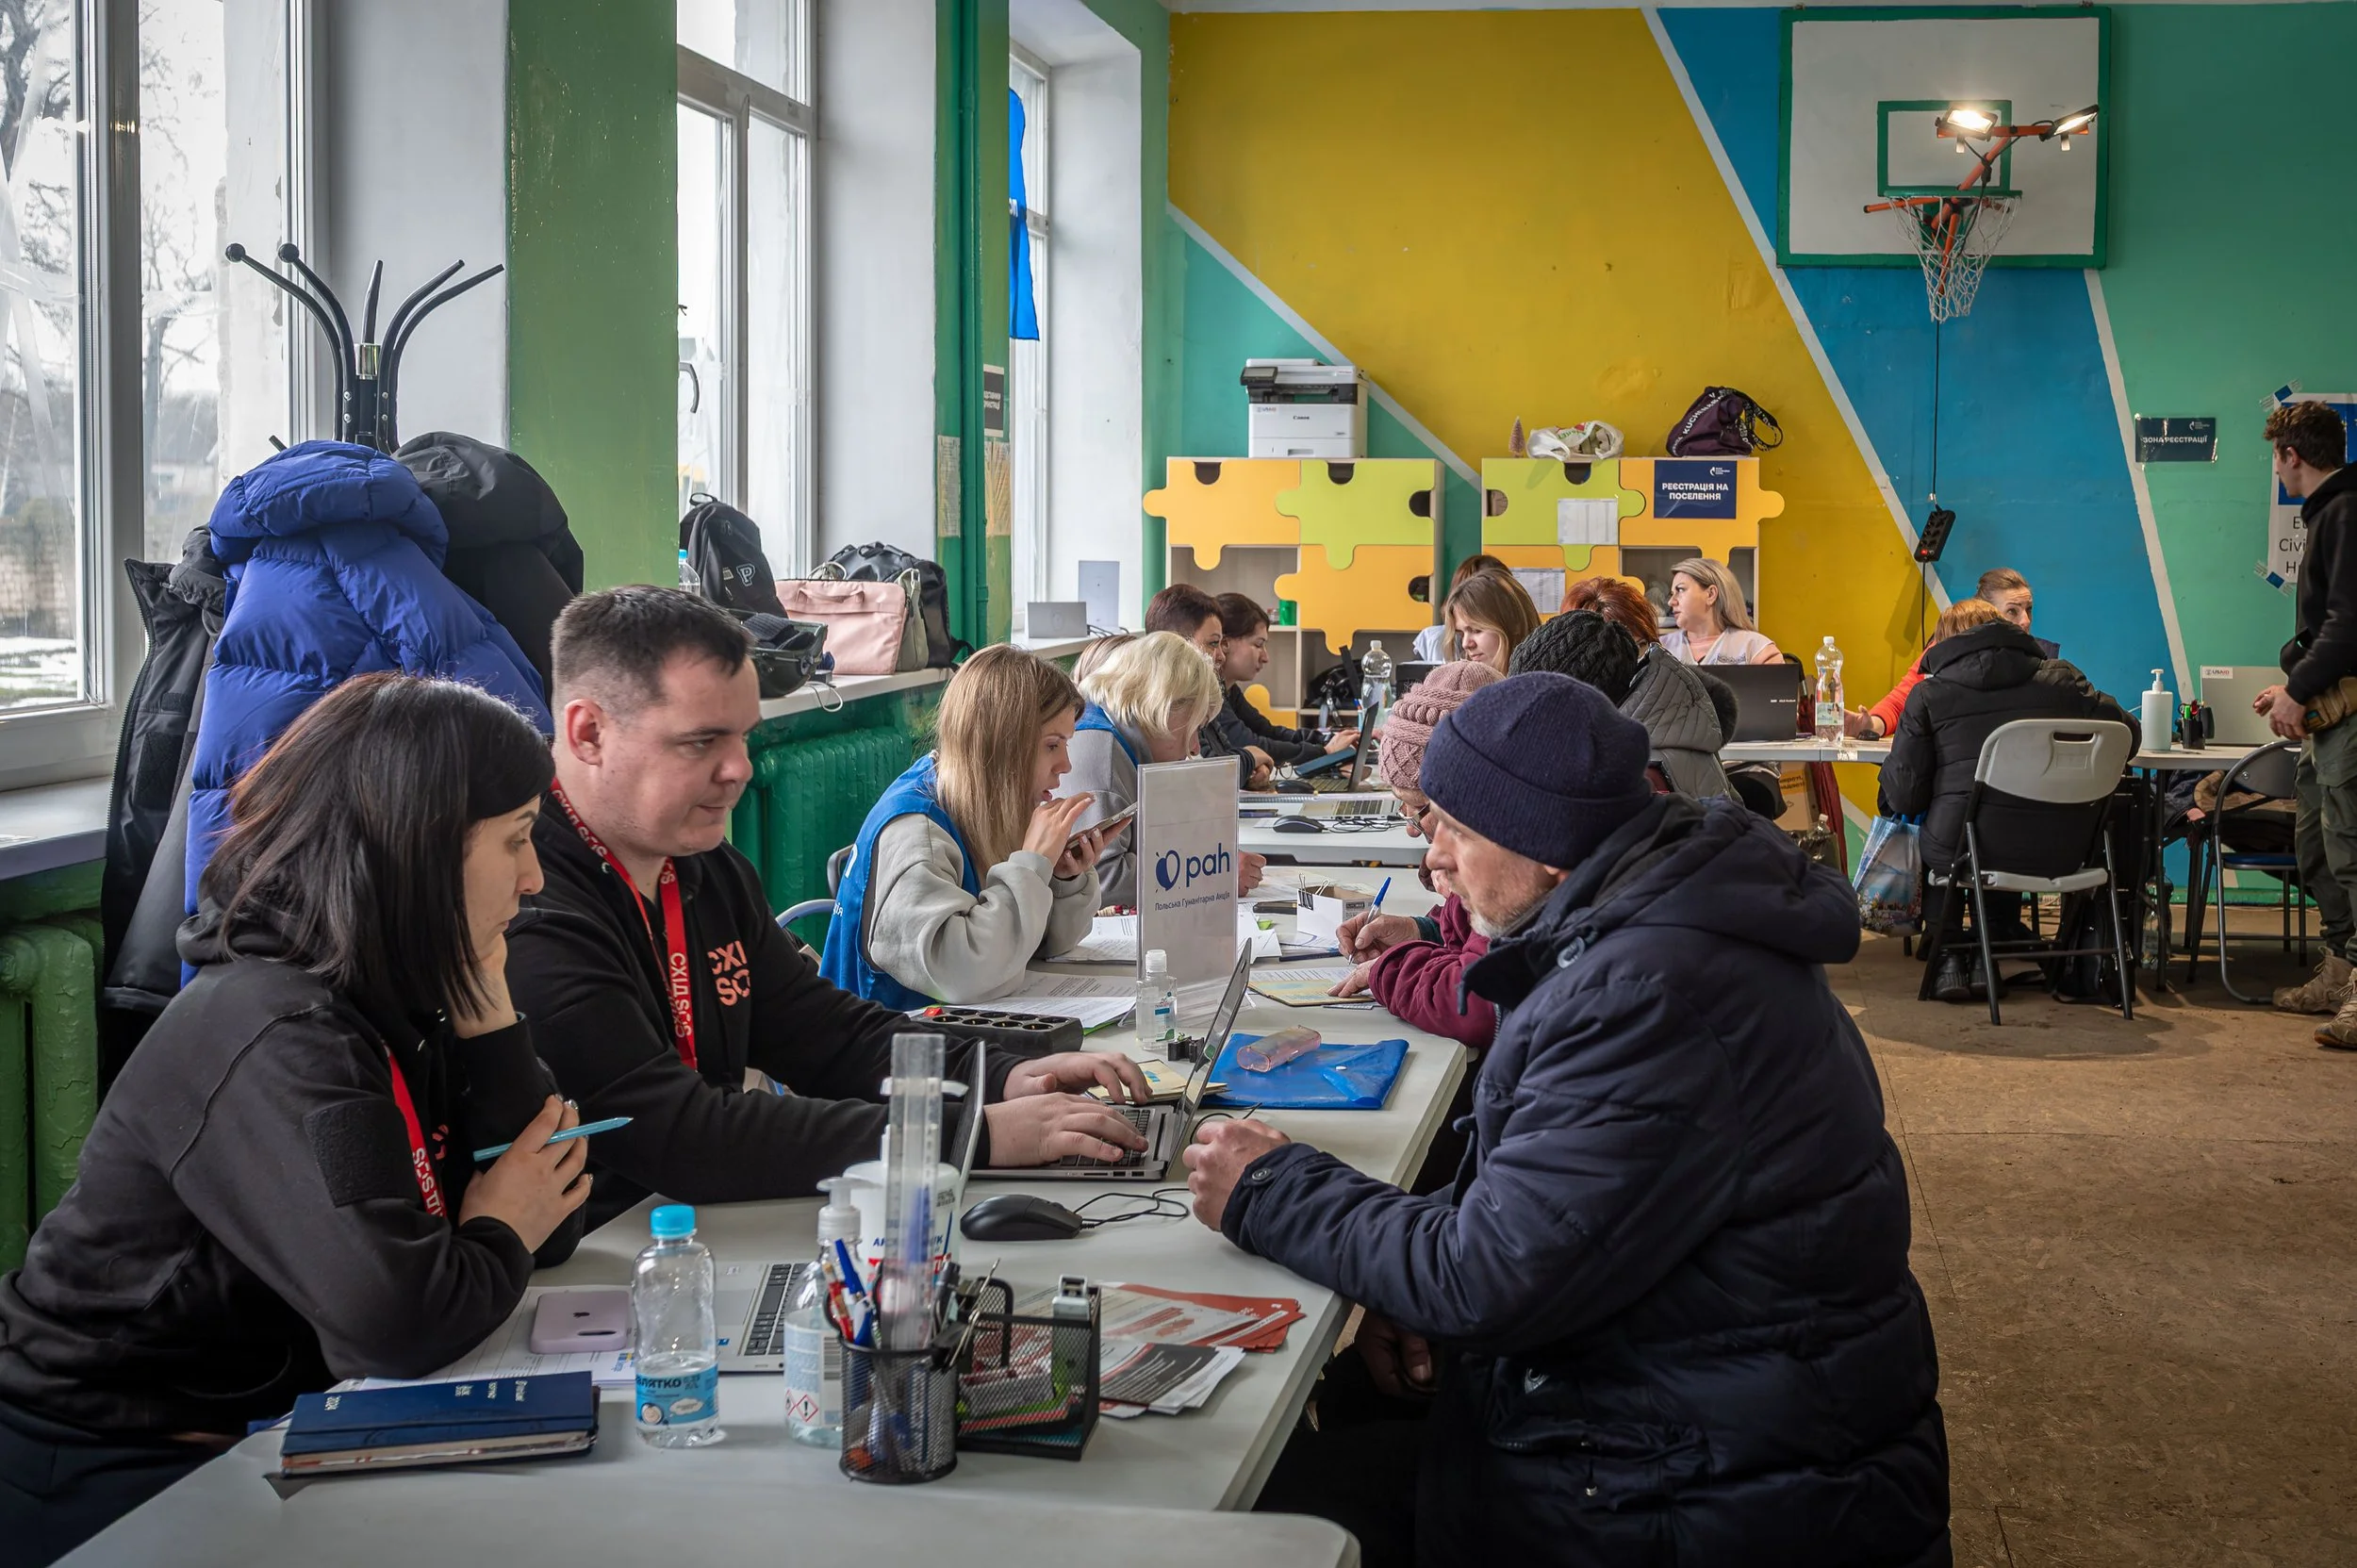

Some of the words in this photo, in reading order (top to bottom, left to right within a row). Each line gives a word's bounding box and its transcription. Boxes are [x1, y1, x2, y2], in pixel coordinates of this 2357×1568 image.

[1662, 483, 1714, 491] РЕЄСТРАЦІЯ
[1669, 492, 1722, 501] ПОСЕЛЕННЯ
[2279, 538, 2306, 552] Civi
[738, 566, 753, 585] P
[1186, 842, 1230, 887] pah
[1155, 900, 1181, 911] Польська
[1215, 891, 1229, 901] Акція
[670, 952, 689, 998] СХІД
[708, 940, 748, 975] СХІ
[716, 968, 750, 1006] SO
[675, 999, 692, 1036] SOS
[412, 1147, 435, 1193] SOS
